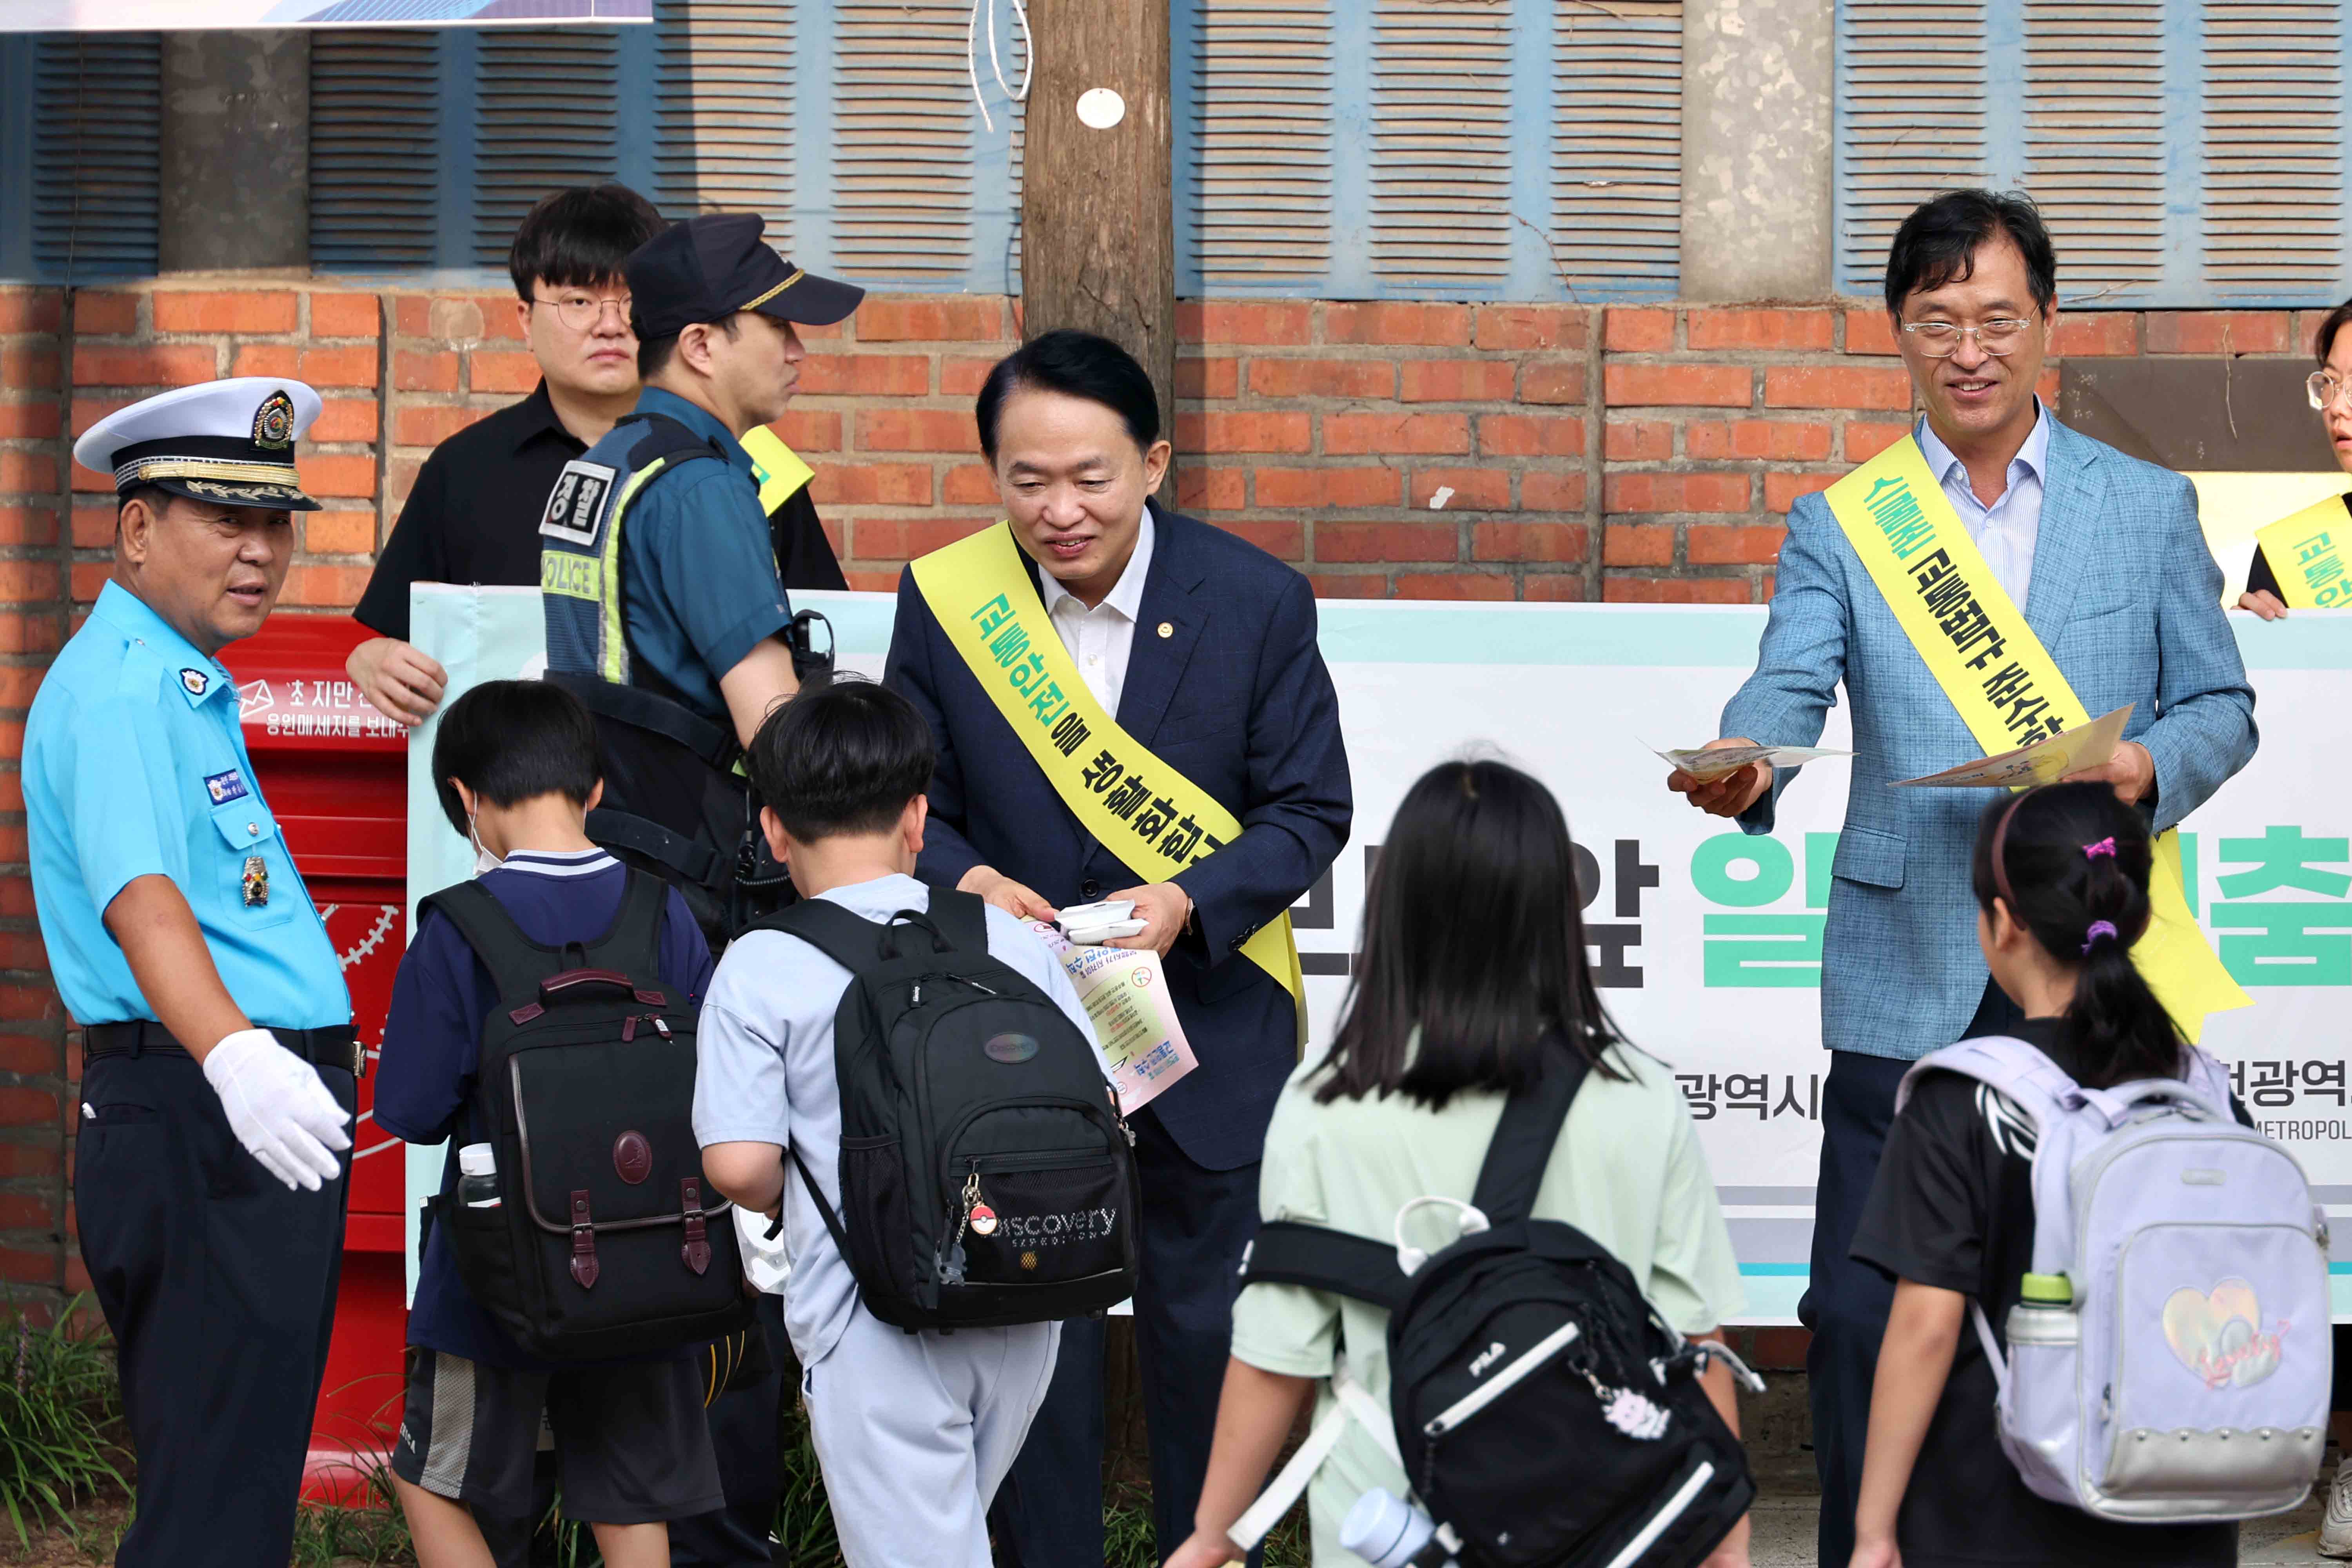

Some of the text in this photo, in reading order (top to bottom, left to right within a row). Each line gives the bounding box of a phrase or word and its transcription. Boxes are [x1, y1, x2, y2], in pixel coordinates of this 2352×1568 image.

[550, 475, 601, 527] 경찰
[541, 557, 591, 593] OLICE
[1864, 475, 1936, 561] 스쿨존
[1907, 548, 2006, 671] 교통법규
[970, 592, 1092, 757] 교통안전을
[267, 713, 361, 737] 응원메세지를
[1690, 832, 1840, 987] 일
[2178, 826, 2352, 986] 춤
[2220, 1060, 2352, 1107] 광역
